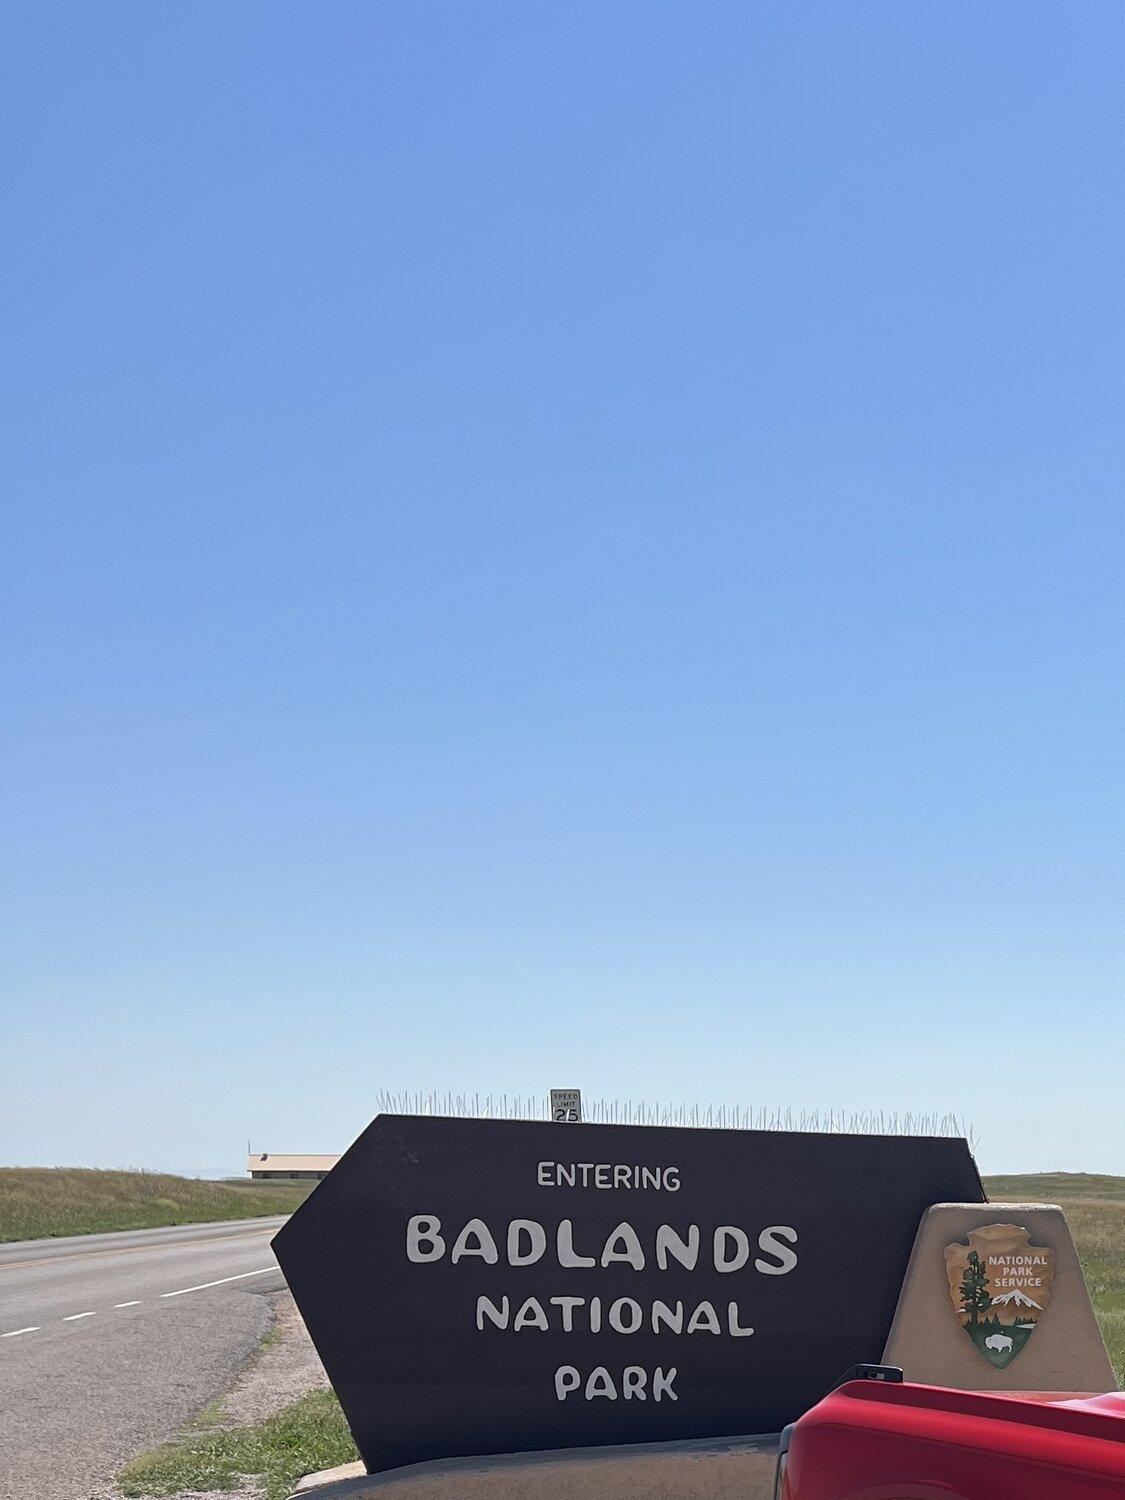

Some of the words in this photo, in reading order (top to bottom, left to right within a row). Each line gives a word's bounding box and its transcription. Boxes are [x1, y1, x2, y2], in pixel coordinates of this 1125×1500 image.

[555, 1108, 578, 1122] 25
[538, 1162, 680, 1191] ENTERING
[407, 1215, 797, 1275] BADLANDS
[989, 1256, 1048, 1265] NATIONAL
[994, 1277, 1042, 1287] SERVICE
[1003, 1267, 1033, 1276] PARK
[477, 1296, 754, 1336] NATIONAL
[555, 1366, 678, 1401] PARK
